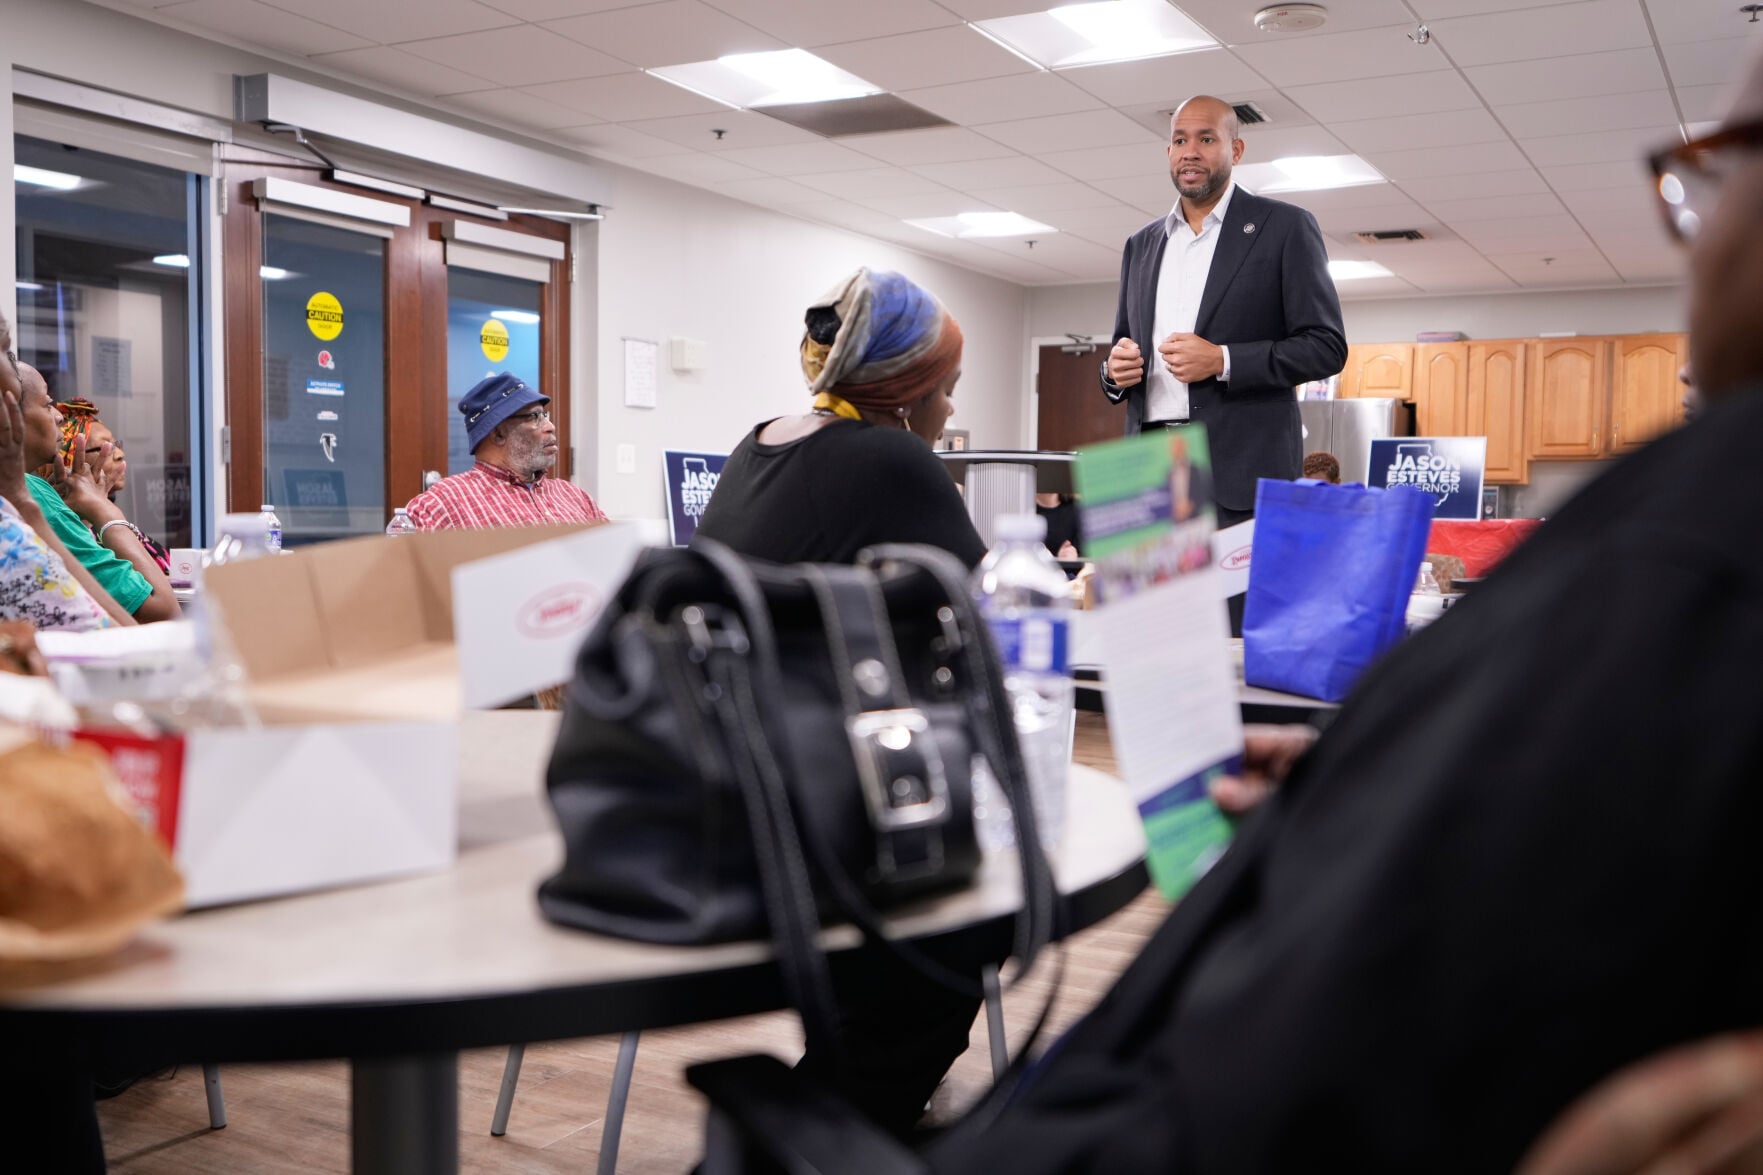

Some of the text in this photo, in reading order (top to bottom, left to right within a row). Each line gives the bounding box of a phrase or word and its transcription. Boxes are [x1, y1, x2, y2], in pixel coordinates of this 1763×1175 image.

[308, 310, 343, 323] CAUTION
[481, 335, 508, 346] CAUTION
[1388, 453, 1461, 471] JASON
[681, 468, 720, 490] JASO
[1386, 470, 1461, 484] ESTEVES
[681, 489, 712, 505] ESTE
